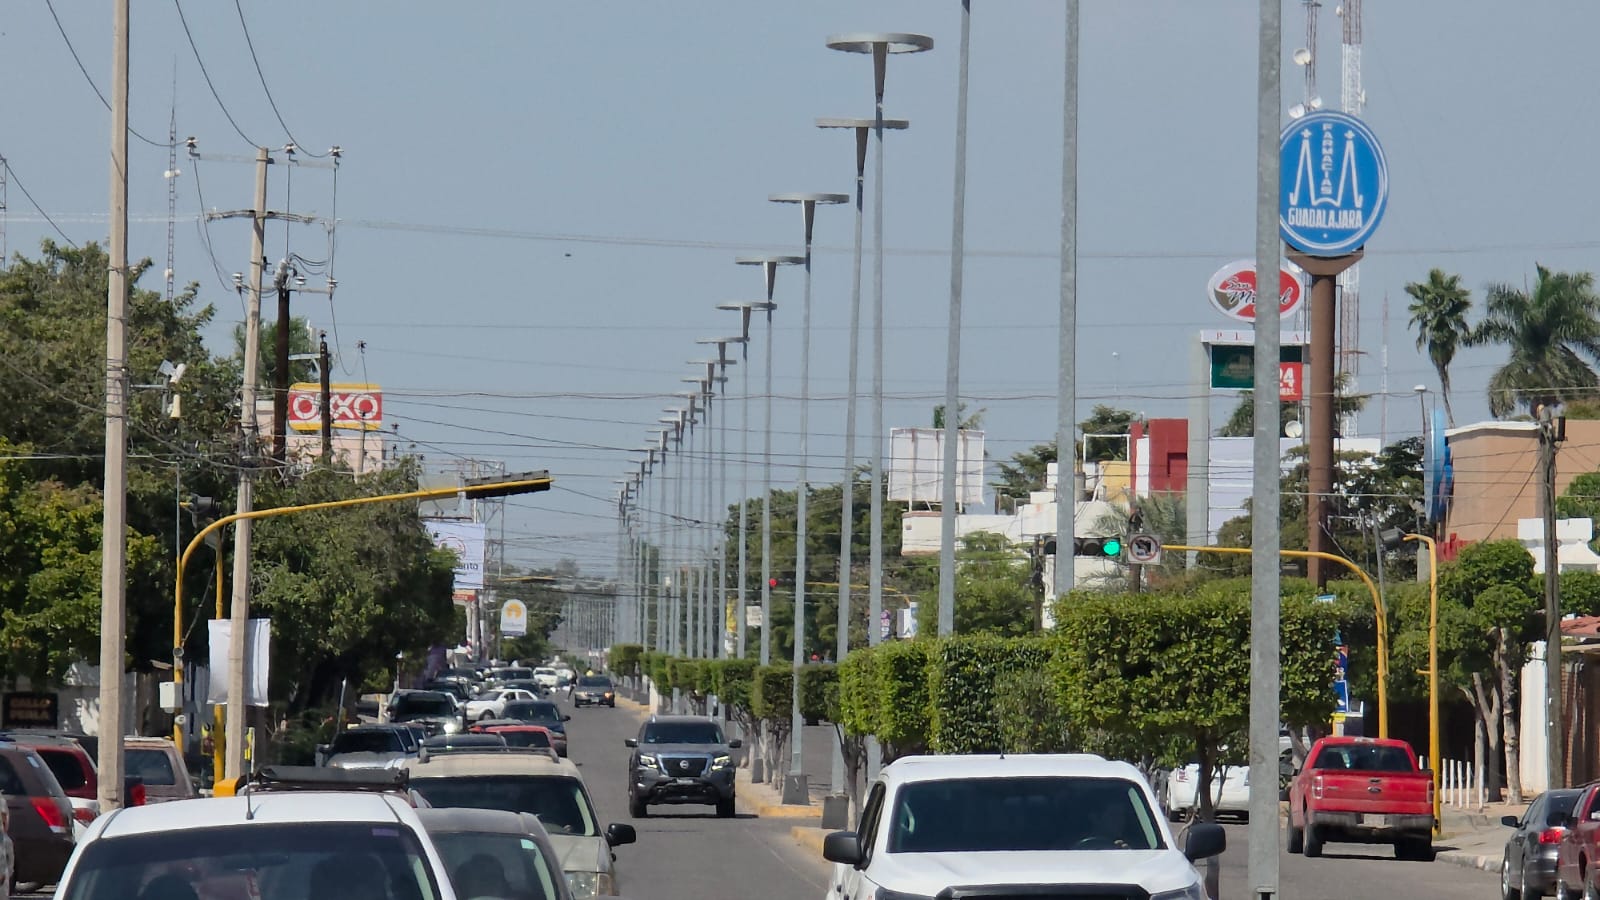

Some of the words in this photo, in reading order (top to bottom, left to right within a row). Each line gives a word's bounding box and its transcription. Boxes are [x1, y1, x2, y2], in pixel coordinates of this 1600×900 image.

[1321, 123, 1334, 195] FARMACIAS
[1288, 207, 1362, 229] GUADALAJARA
[1227, 275, 1251, 289] San
[1229, 286, 1293, 304] Mil
[1216, 331, 1301, 341] PLA
[293, 394, 379, 420] OXXO
